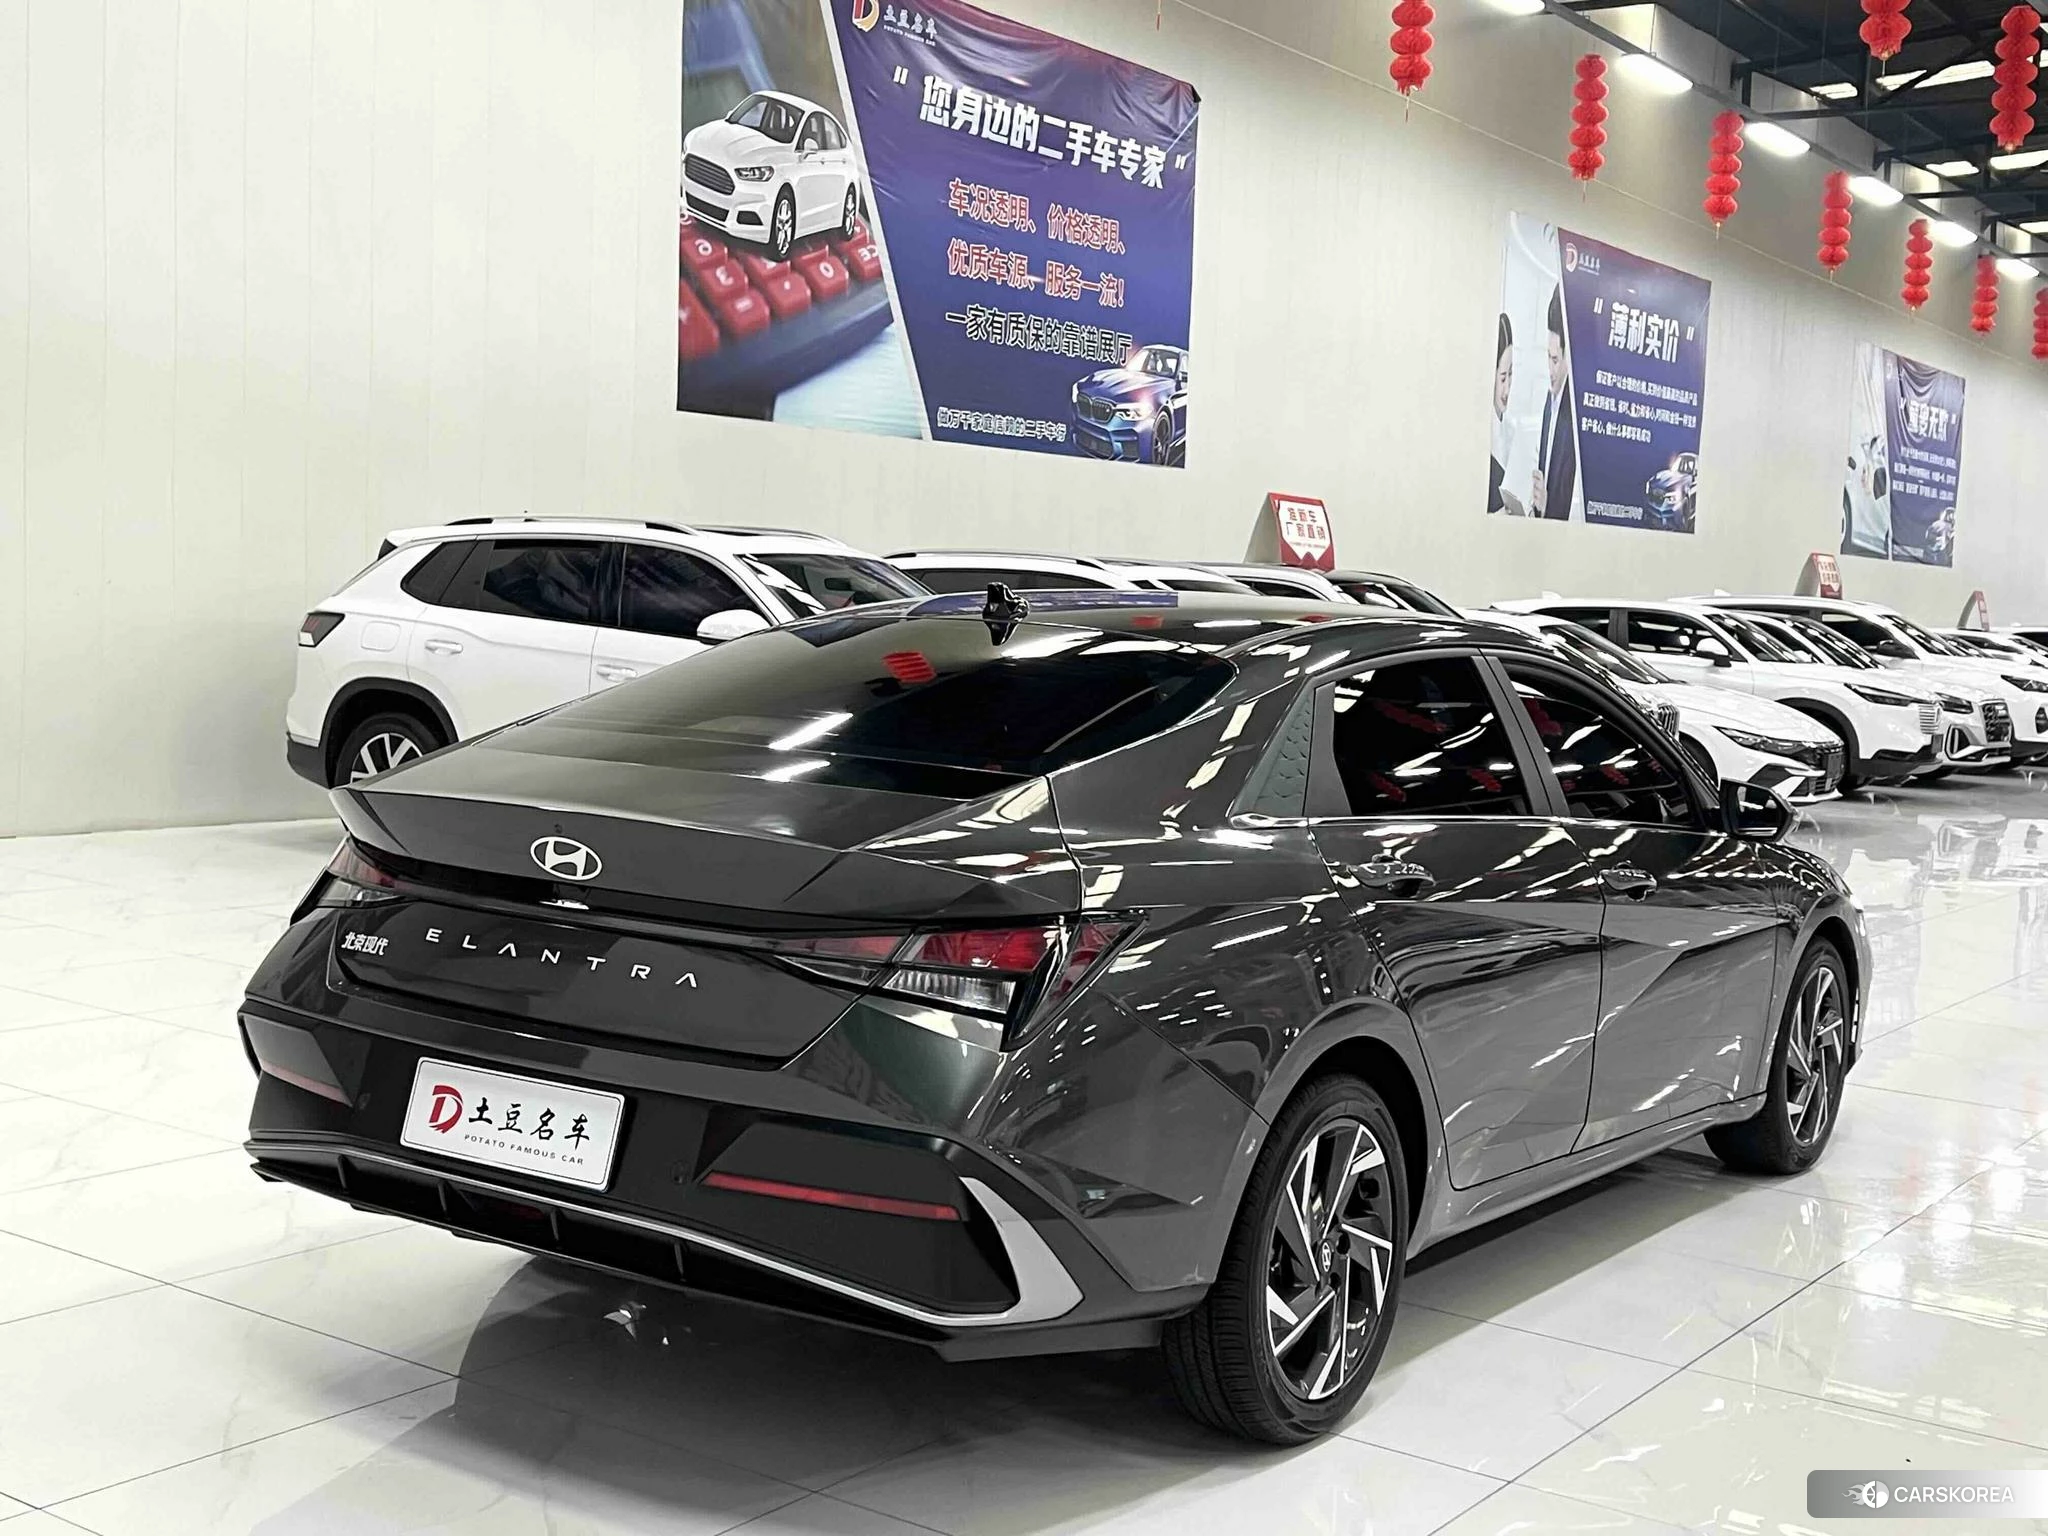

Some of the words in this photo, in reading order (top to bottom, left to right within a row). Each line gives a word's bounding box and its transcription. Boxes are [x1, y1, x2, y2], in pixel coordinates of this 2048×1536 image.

[946, 304, 1133, 366] 一家有质保的靠谱展厅
[341, 931, 389, 956] 北京现代
[426, 928, 698, 988] ELANTRA
[464, 1134, 505, 1149] POTATO
[510, 1144, 556, 1159] FAMOUS
[561, 1154, 584, 1166] CAR
[468, 1097, 590, 1150] 土豆名车
